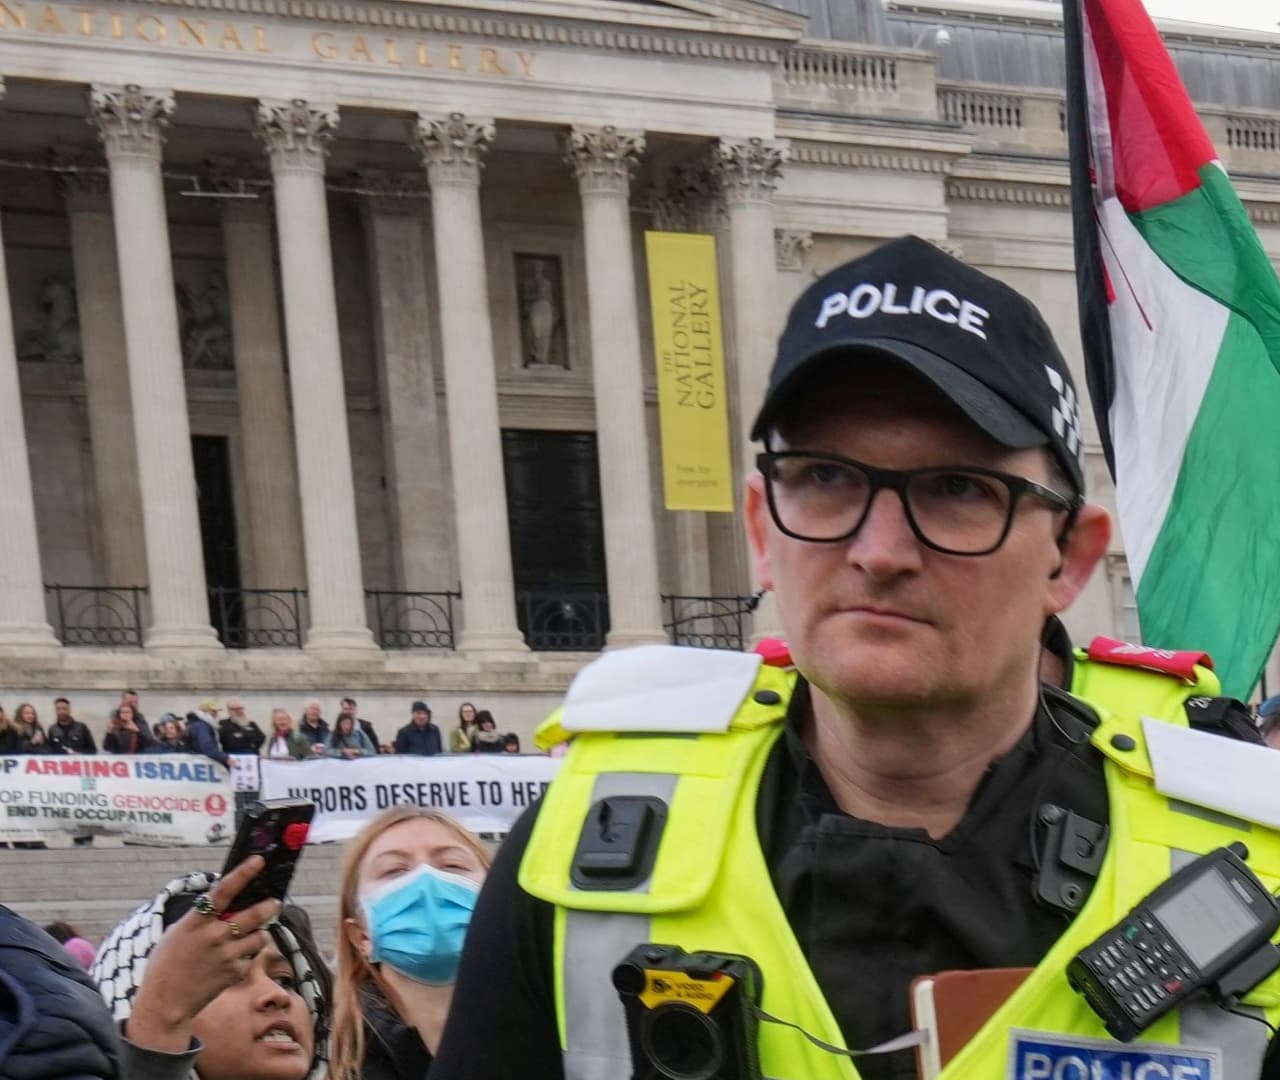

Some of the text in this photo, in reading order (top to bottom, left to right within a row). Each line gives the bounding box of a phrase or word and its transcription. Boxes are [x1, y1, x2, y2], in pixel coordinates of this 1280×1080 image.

[0, 2, 538, 78] NATIONAL GALLERY
[815, 283, 990, 341] POLICE
[669, 280, 694, 407] NATIONAL
[688, 282, 716, 410] GALLERY
[25, 759, 130, 778] ARMING
[135, 761, 222, 783] ISRAEL
[7, 806, 173, 824] END THE OCCUPATION
[29, 791, 108, 807] FUNDING
[112, 796, 200, 813] GENOCIDE
[376, 781, 470, 809] DESERVE
[476, 780, 501, 806] TO
